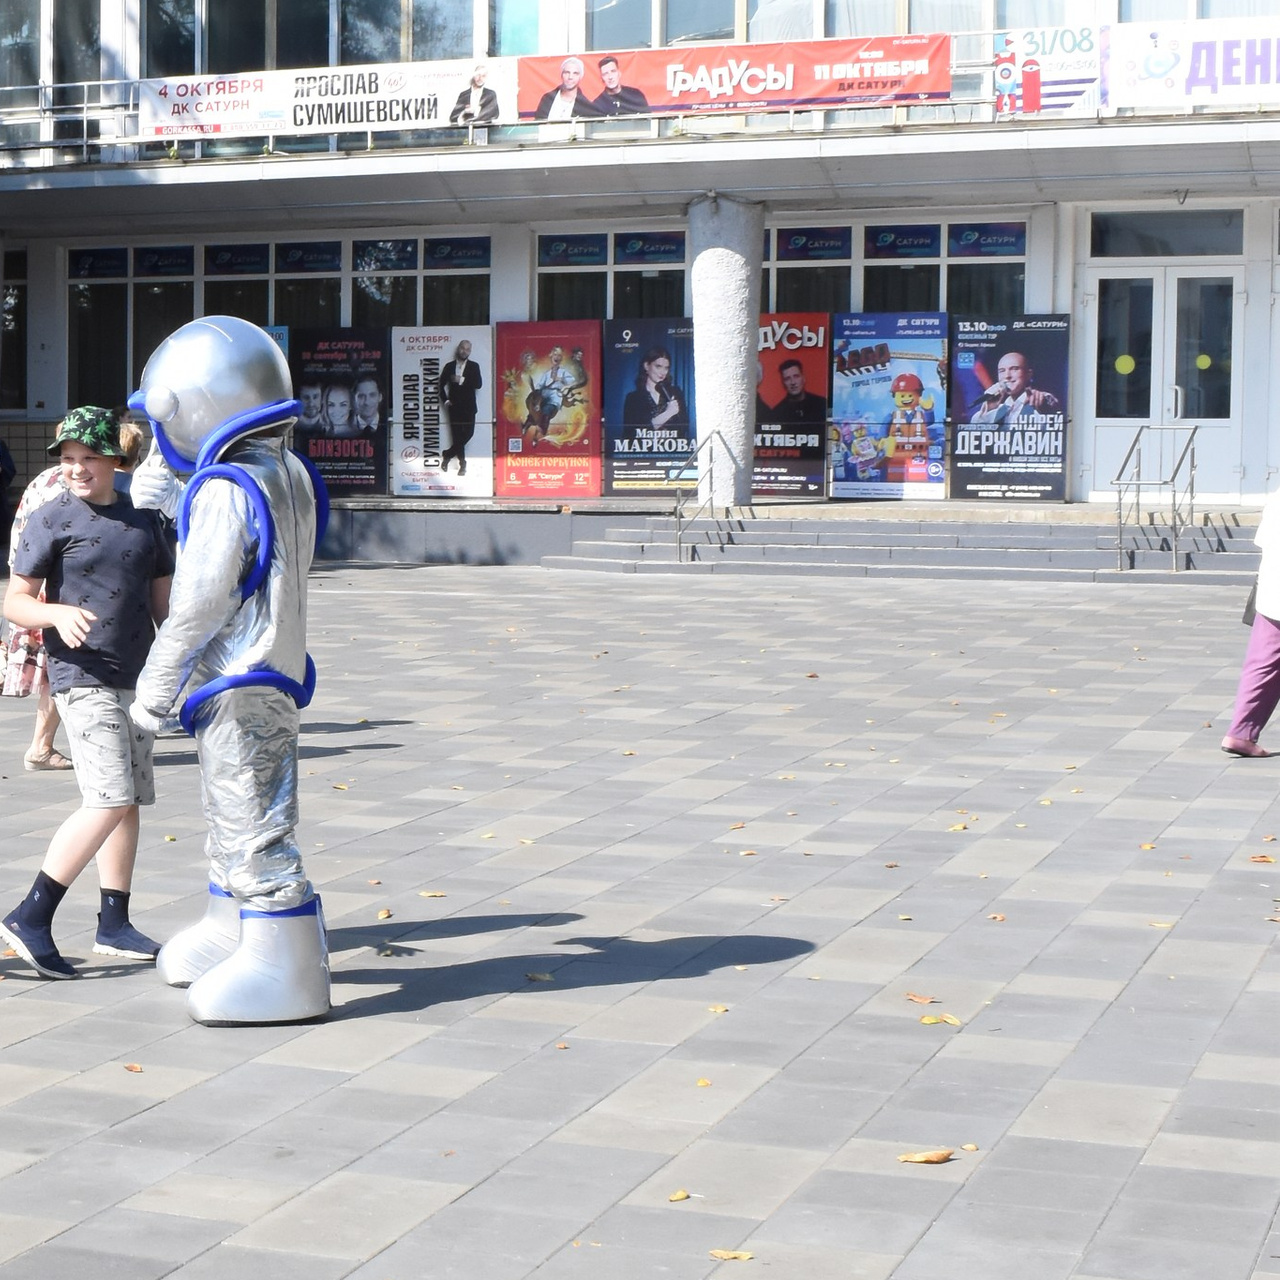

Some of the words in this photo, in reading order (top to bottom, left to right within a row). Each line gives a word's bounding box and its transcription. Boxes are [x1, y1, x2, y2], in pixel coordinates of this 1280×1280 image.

[1023, 28, 1095, 56] 31/08
[814, 64, 830, 80] 11
[832, 59, 929, 79] ОКТЯБРЯ
[1185, 38, 1280, 95] ДЕН
[158, 85, 168, 98] 4
[176, 79, 264, 97] ОКТЯБРЯ
[294, 72, 379, 98] ЯРОСЛАВ
[666, 59, 795, 99] ГРАДУСЫ
[837, 82, 854, 92] ДК
[858, 80, 905, 89] САТУРН
[172, 103, 189, 116] ДК
[195, 100, 250, 113] САТУРН
[293, 94, 439, 127] СУМИШЕВСКИЙ
[622, 329, 632, 342] 9
[958, 322, 987, 331] 13.10
[403, 374, 419, 439] ЯРОСЛАВ
[420, 357, 440, 467] СУМИШЕВСКИЙ
[1009, 411, 1063, 430] АНДРЕЙ
[635, 428, 678, 440] Мария
[955, 431, 1063, 455] ДЕРЖАВИН
[309, 439, 374, 458] БЛИЗОСТЬ
[613, 438, 698, 453] МАРКОВА
